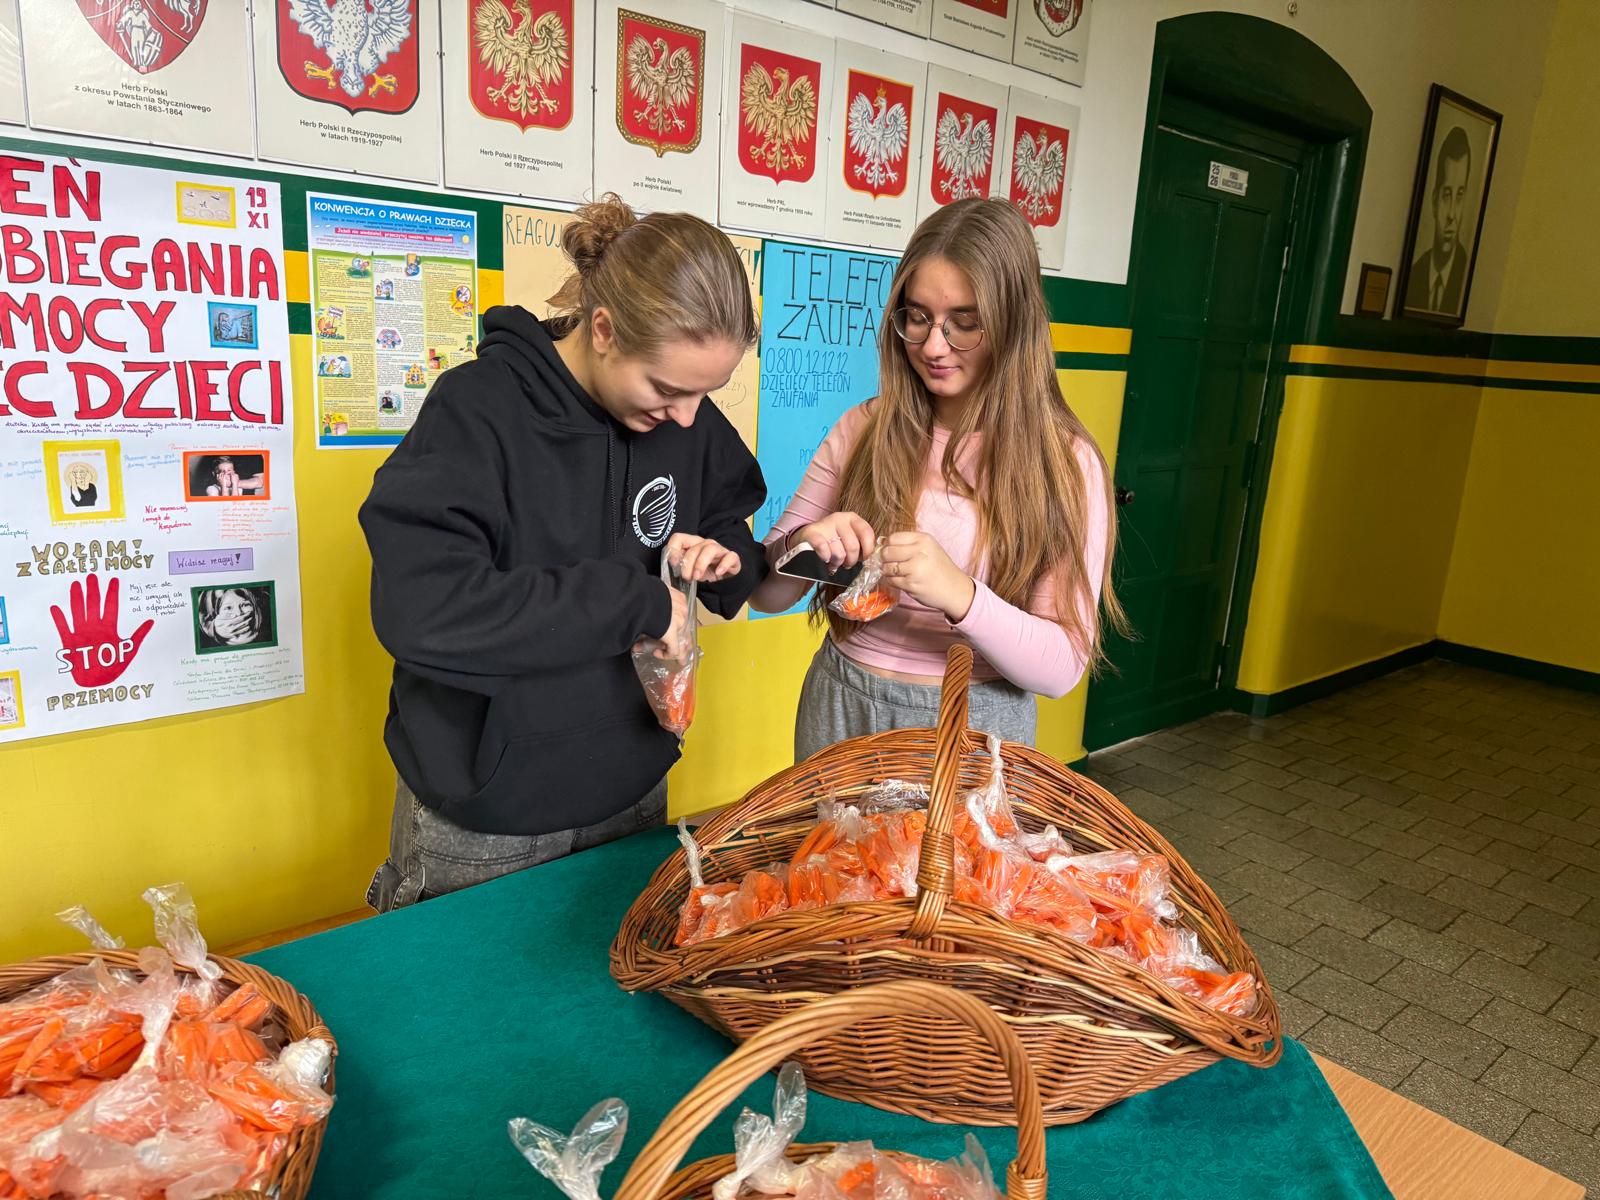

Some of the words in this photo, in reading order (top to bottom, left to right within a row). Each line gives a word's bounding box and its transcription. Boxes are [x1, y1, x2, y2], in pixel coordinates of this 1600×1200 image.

[81, 86, 111, 96] okresu
[113, 90, 156, 104] Powstania
[157, 97, 212, 113] Styczniowego
[121, 82, 141, 92] Herb
[143, 86, 168, 97] Polski
[116, 99, 142, 110] latach
[144, 104, 183, 116] 1863-1864
[299, 119, 316, 128] Herb
[318, 122, 340, 132] Polski
[347, 127, 402, 144] Rzeczypospolitej
[328, 131, 349, 141] latach
[351, 136, 383, 147] 1919-1927
[480, 148, 494, 157] Herb
[494, 150, 512, 159] Polski
[518, 154, 563, 169] Rzeczypospolitej
[1211, 164, 1220, 176] 25
[245, 186, 267, 208] 19
[247, 210, 269, 229] XI
[313, 201, 375, 218] KONWENCJA
[378, 209, 387, 219] O
[389, 210, 432, 224] PRAWACH
[434, 216, 472, 229] DZIECKA
[505, 213, 562, 248] REAGUJ
[0, 223, 280, 301] BIEGANIA
[783, 248, 900, 308] TELEFO
[0, 291, 177, 354] MOCY
[0, 359, 58, 418] C
[67, 360, 284, 424] DZIECI
[812, 374, 851, 393] TELEFON
[771, 391, 819, 408] ZAUFANIA
[16, 562, 32, 577] Z
[37, 558, 98, 575] CAŁEJ
[104, 554, 154, 571] MOCY
[56, 638, 134, 674] STOP
[46, 683, 154, 711] PRZEMOCY
